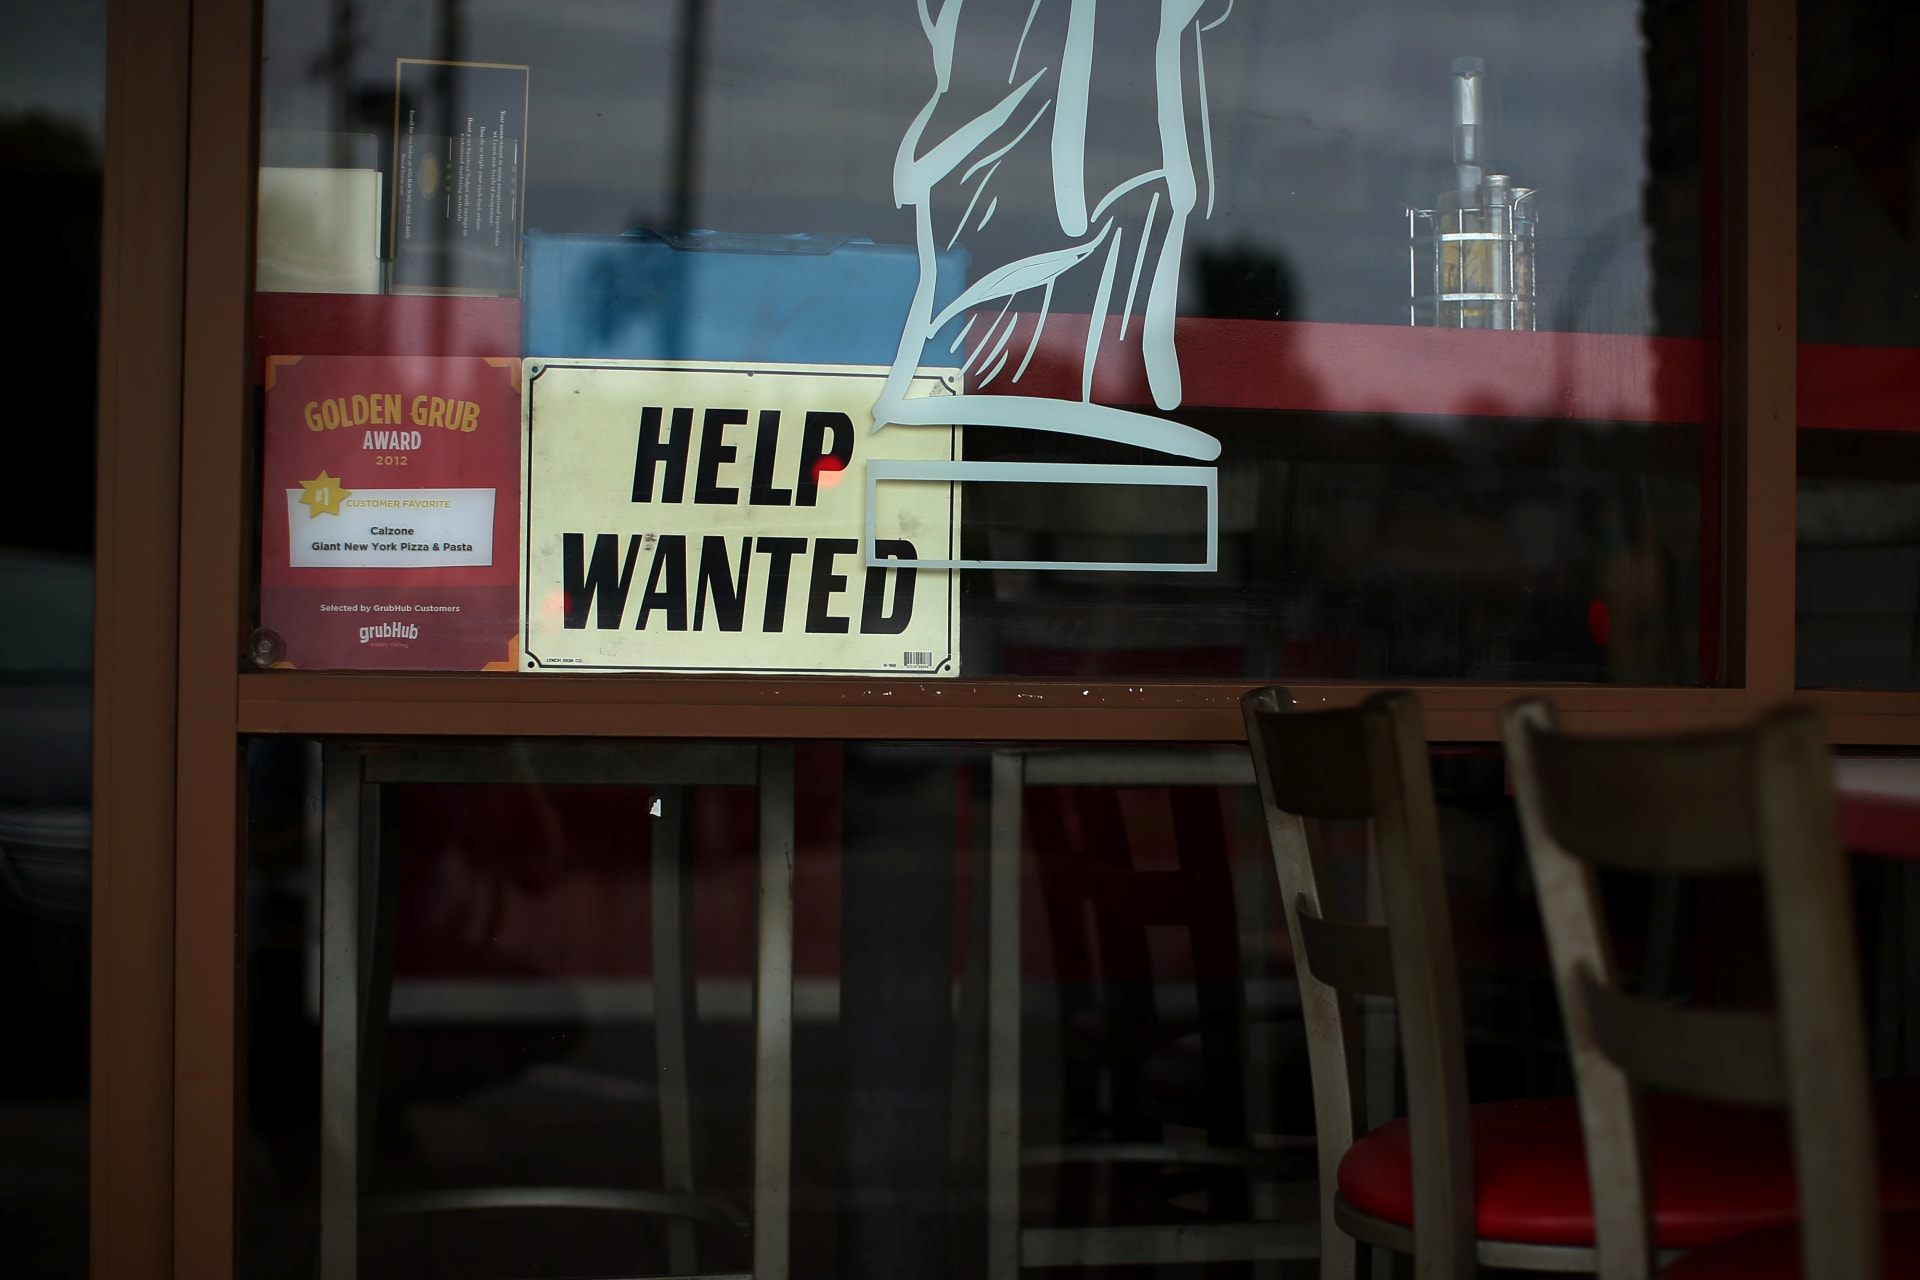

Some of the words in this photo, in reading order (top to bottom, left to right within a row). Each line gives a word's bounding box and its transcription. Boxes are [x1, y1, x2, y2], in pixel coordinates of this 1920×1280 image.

[304, 393, 402, 432] GOLDEN
[410, 395, 480, 433] GRUB
[363, 430, 422, 450] AWARD
[376, 456, 408, 466] 2012
[631, 406, 855, 507] HELP
[315, 487, 329, 506] #1
[346, 500, 400, 508] CUSTOMER
[403, 500, 451, 508] FAVORITE
[370, 526, 414, 536] Calzone
[312, 541, 341, 552] Giant
[344, 542, 369, 551] New
[371, 541, 397, 551] York
[400, 541, 429, 552] Pizza
[432, 542, 440, 552] &
[443, 542, 473, 552] Pasta
[562, 532, 918, 635] WANTED
[320, 604, 358, 612] Selected
[360, 604, 371, 613] by
[373, 604, 412, 612] GrubHub
[414, 604, 460, 612] Customers
[359, 621, 419, 644] grubHub
